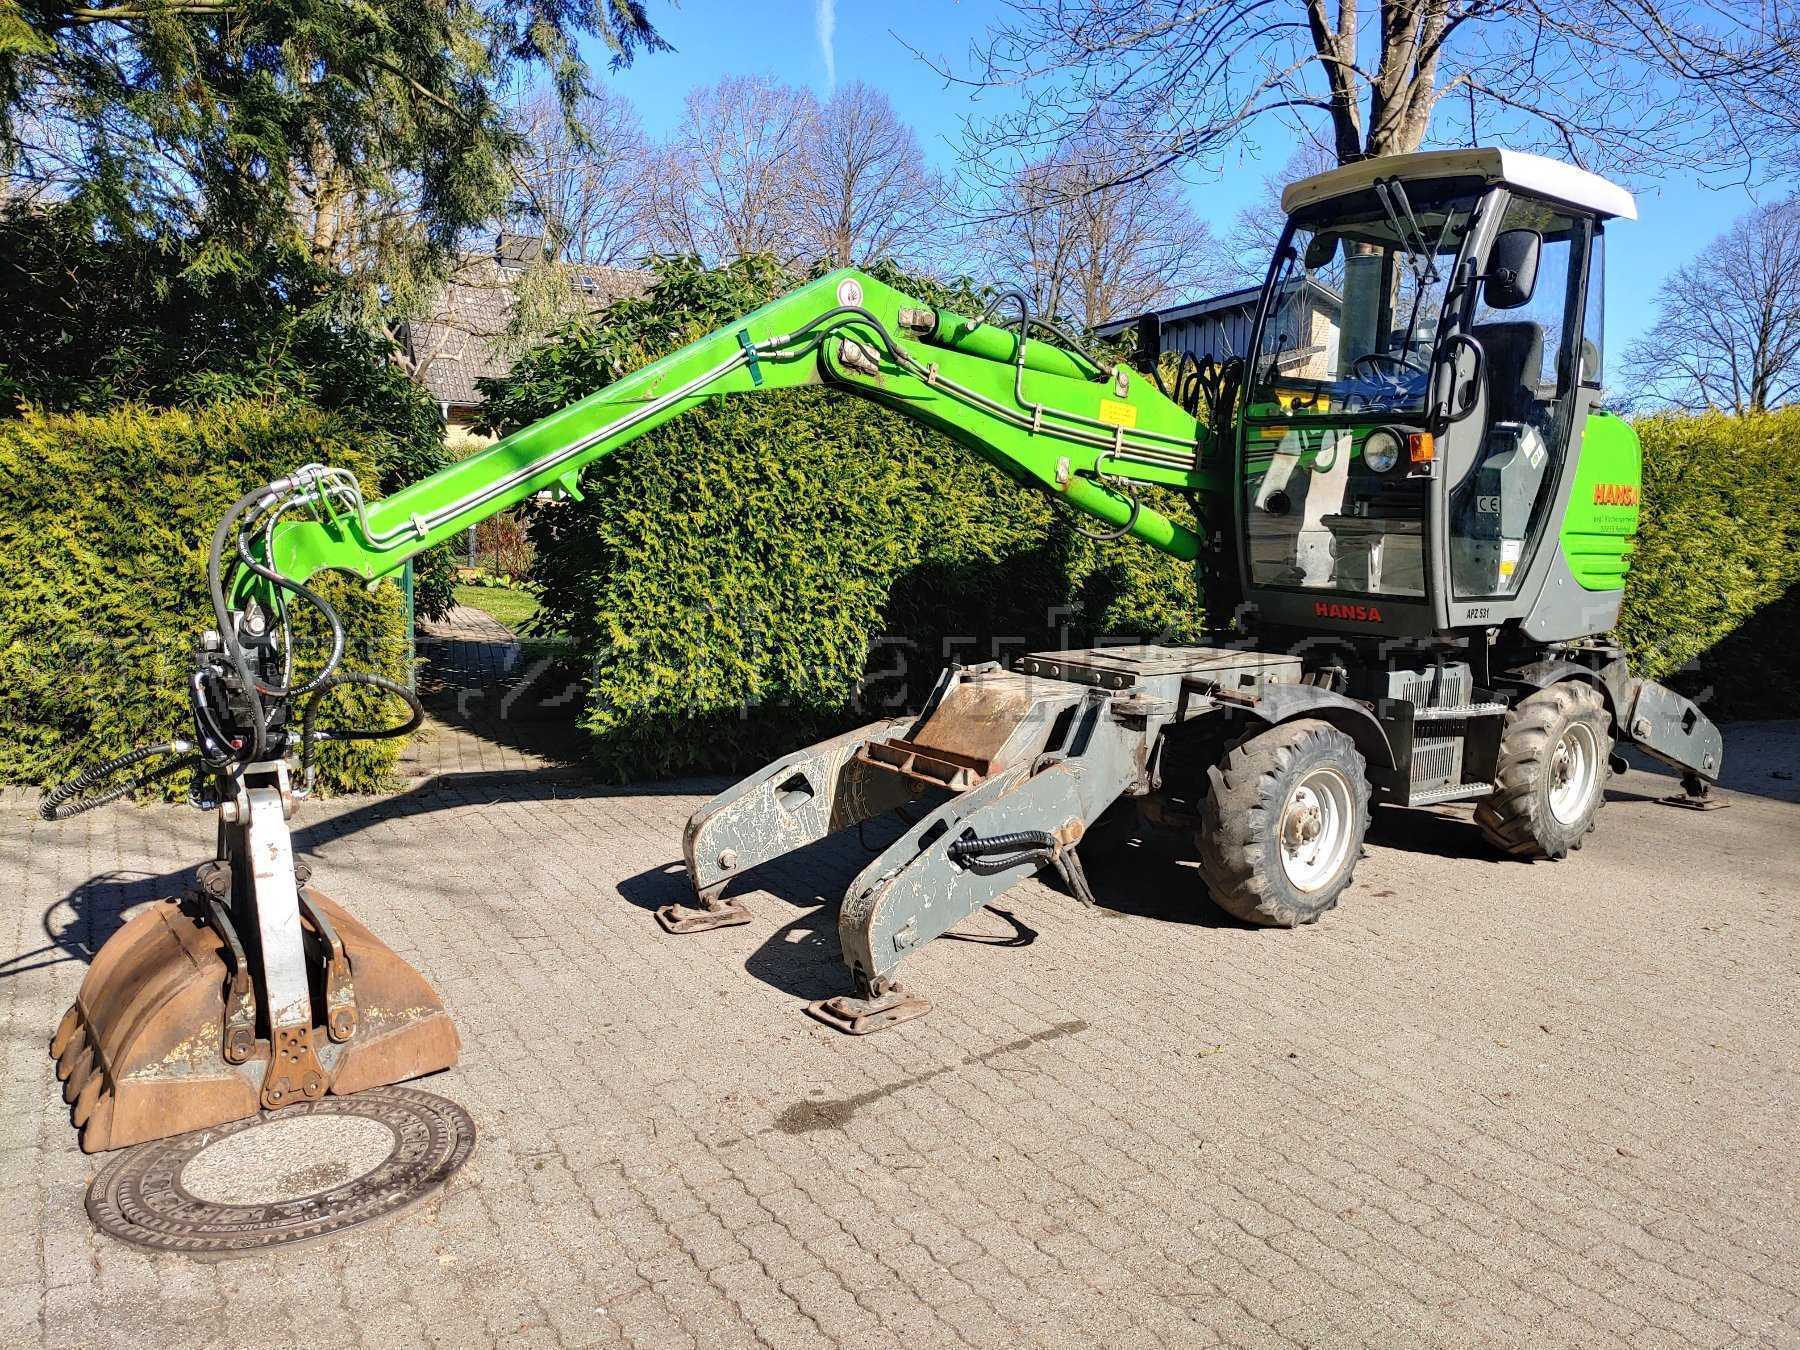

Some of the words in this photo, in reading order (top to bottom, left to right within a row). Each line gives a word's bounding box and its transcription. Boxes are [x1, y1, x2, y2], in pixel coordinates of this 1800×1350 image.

[1314, 601, 1382, 623] HANSA
[1466, 608, 1479, 619] APZ
[1480, 607, 1490, 619] 531
